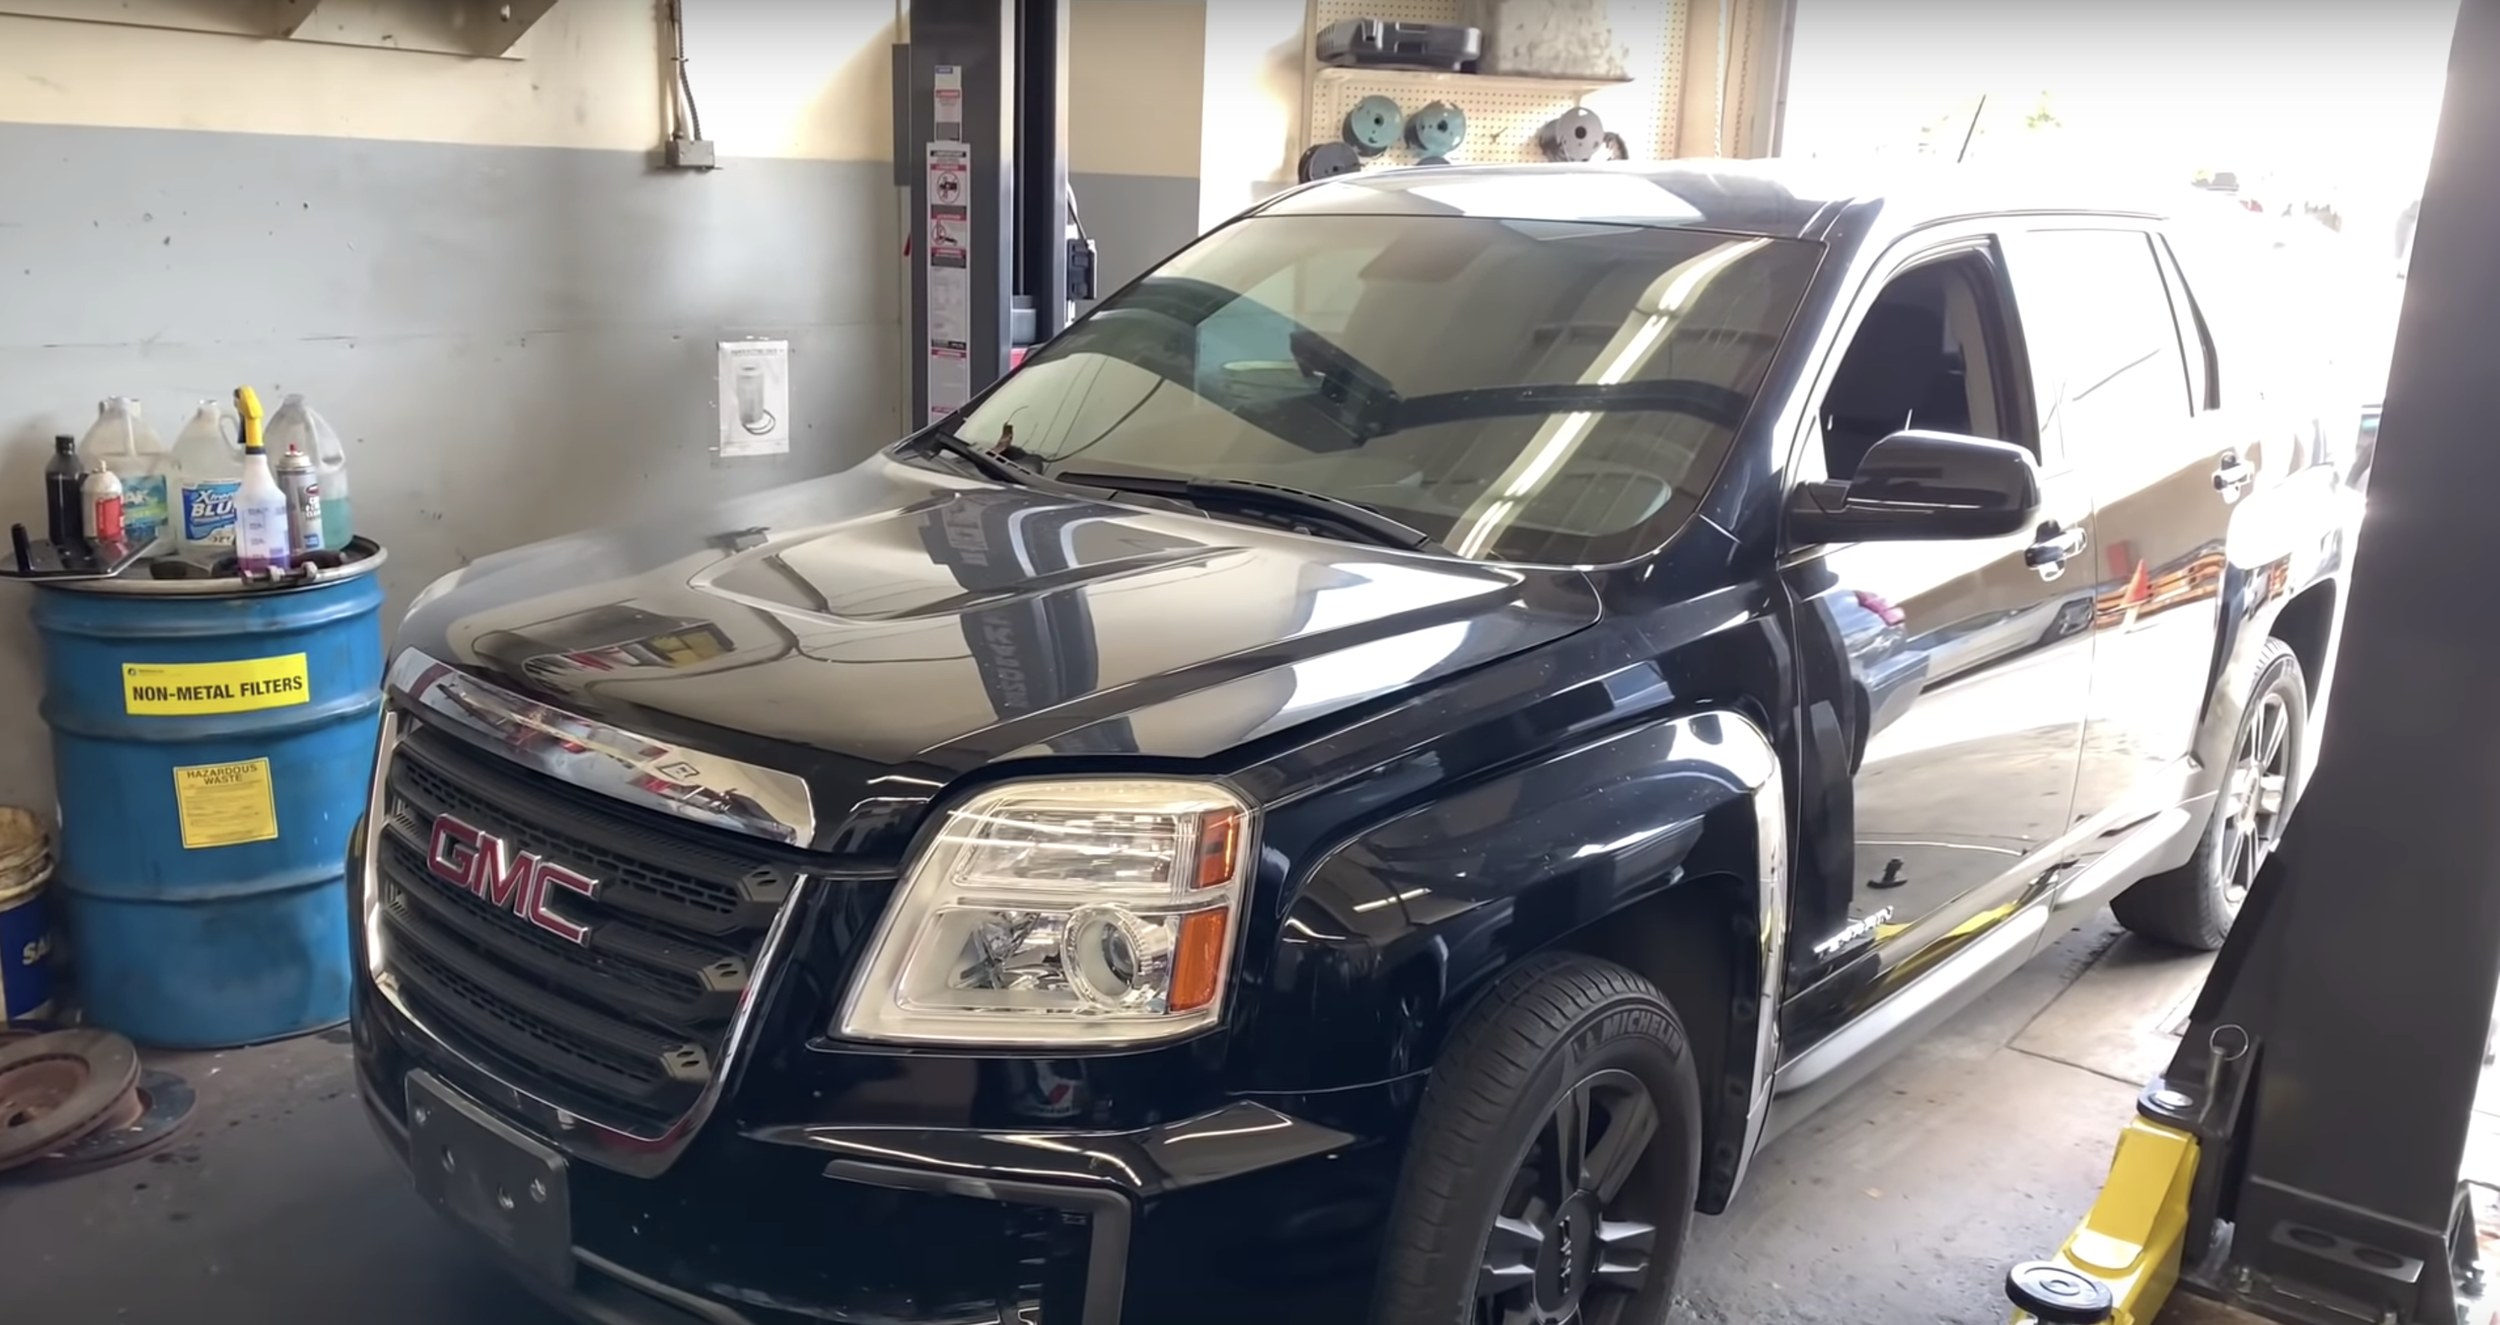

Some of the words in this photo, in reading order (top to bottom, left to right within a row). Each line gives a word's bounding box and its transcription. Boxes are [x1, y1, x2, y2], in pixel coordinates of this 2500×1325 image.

[191, 500, 235, 517] BLU
[132, 684, 235, 701] NON-METAL
[240, 675, 303, 697] FILTERS
[186, 764, 258, 779] HAZARDOUS
[203, 774, 243, 785] WASTE
[427, 813, 599, 948] GMC
[1601, 1010, 1683, 1055] MICHELIN
